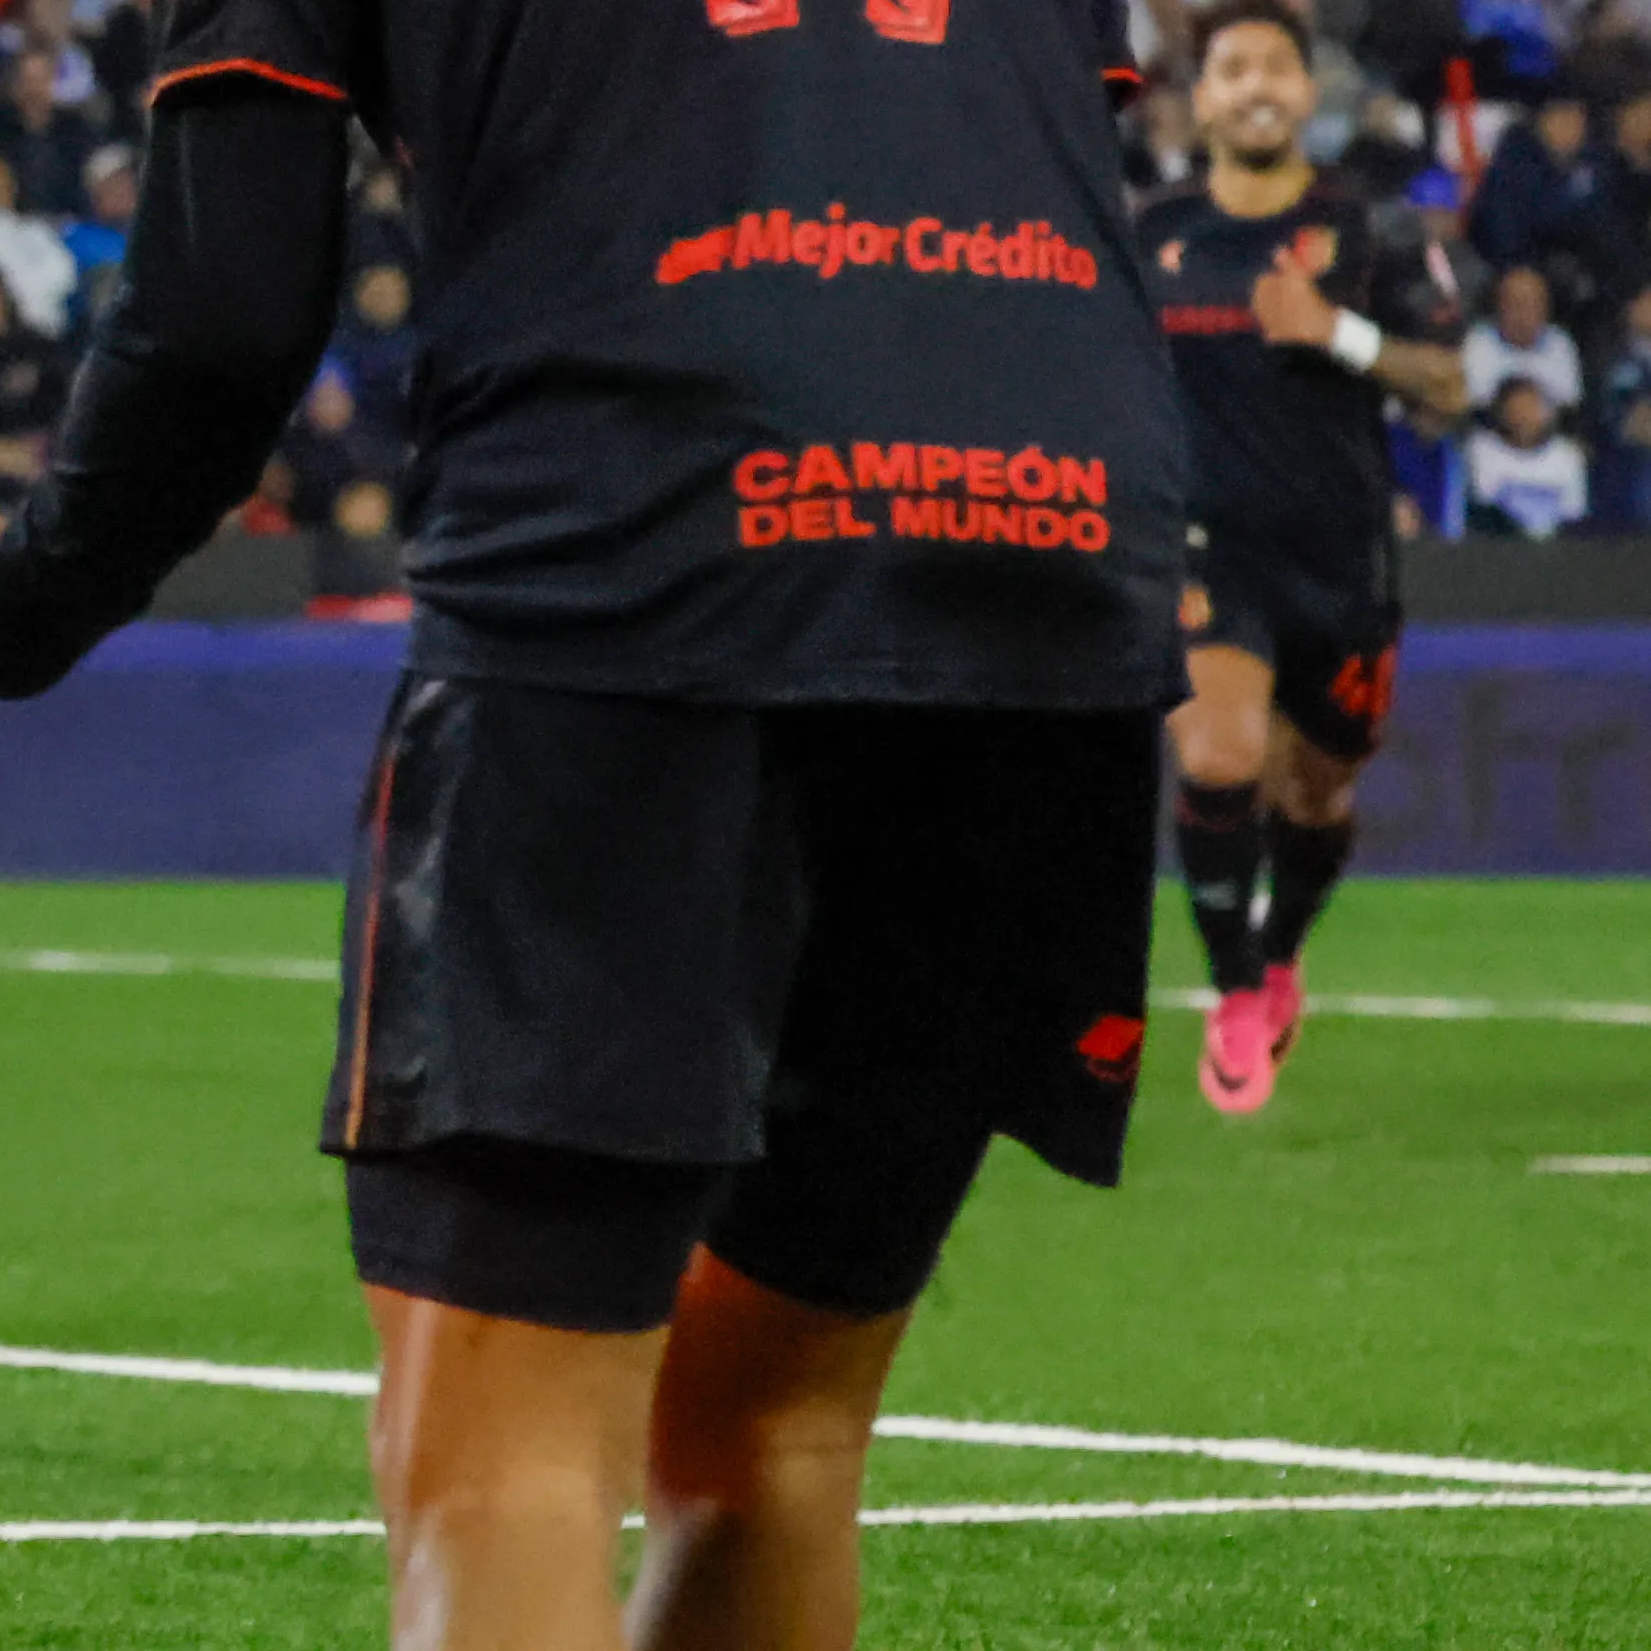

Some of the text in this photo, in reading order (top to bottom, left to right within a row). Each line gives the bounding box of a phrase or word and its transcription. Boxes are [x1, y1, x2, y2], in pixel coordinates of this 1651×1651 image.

[732, 443, 1108, 504] CAMPEÓN
[738, 497, 1110, 553] DEL MUNDO
